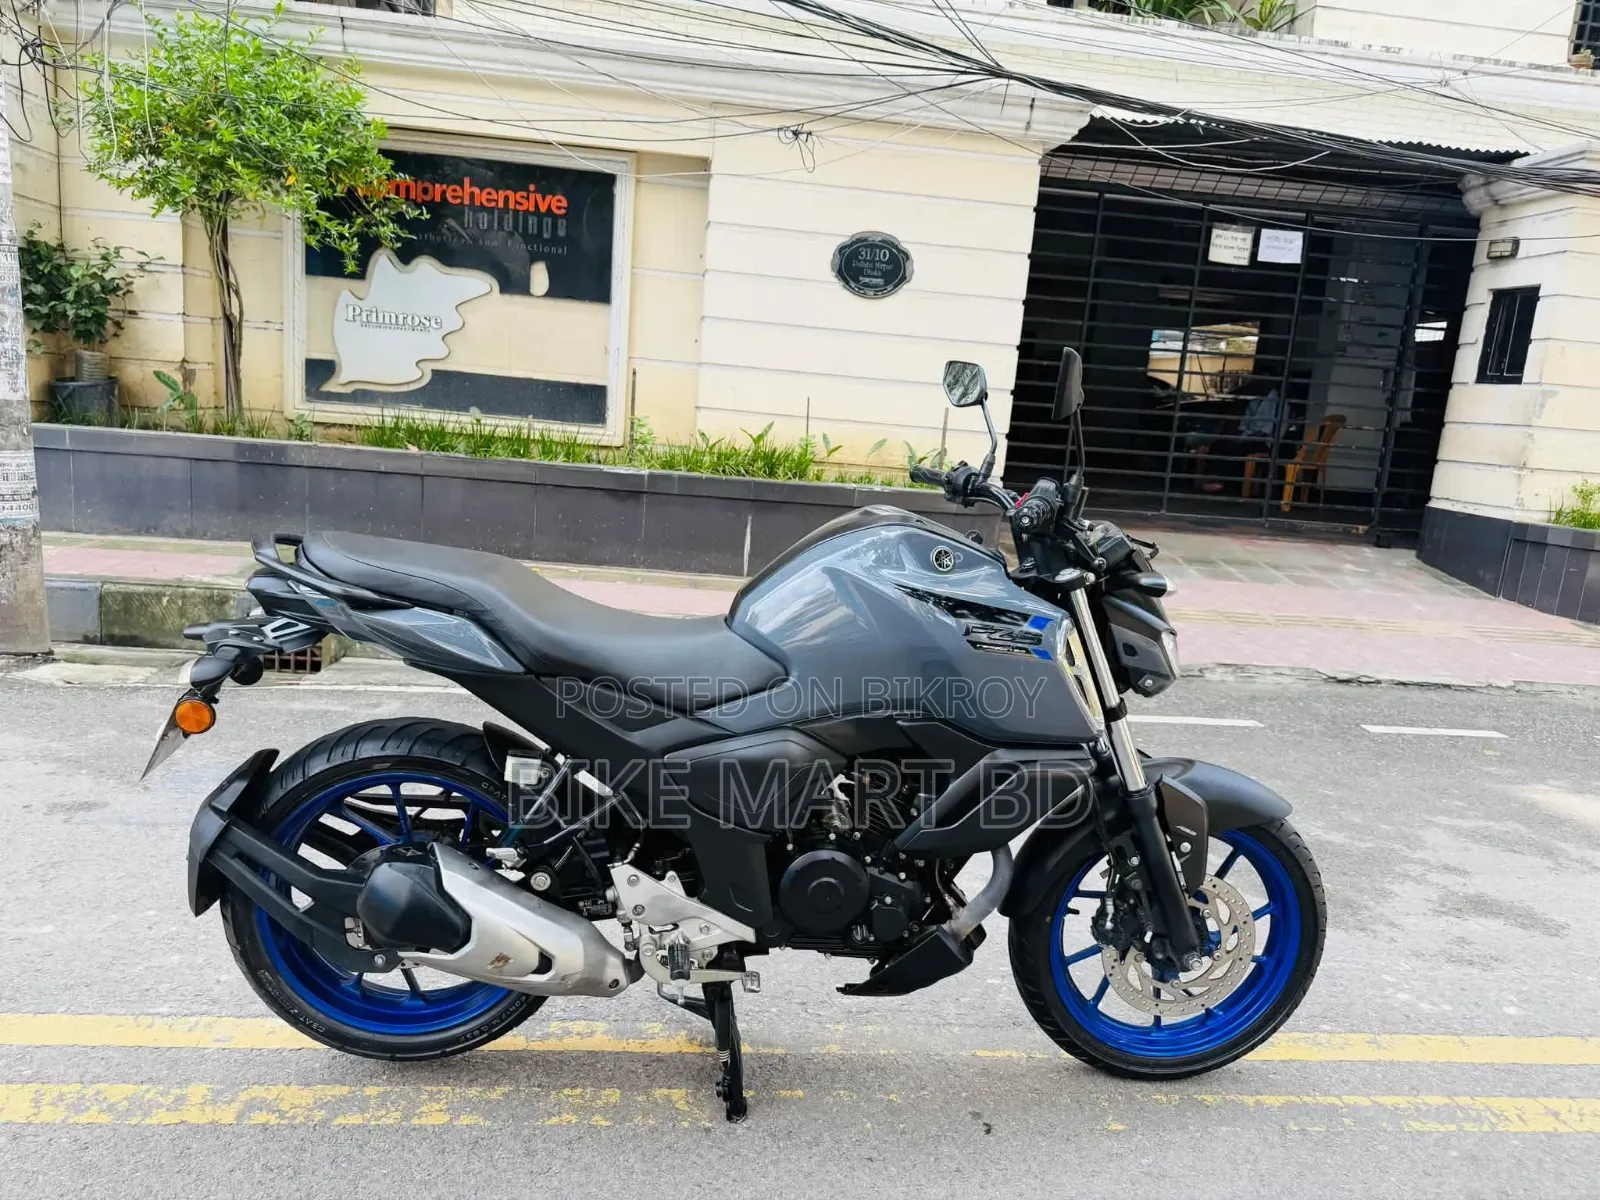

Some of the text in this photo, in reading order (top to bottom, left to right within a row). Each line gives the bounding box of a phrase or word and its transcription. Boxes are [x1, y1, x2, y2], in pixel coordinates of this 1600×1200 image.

[464, 207, 567, 239] holdings
[858, 247, 890, 261] 31/10
[345, 303, 443, 330] Primrose
